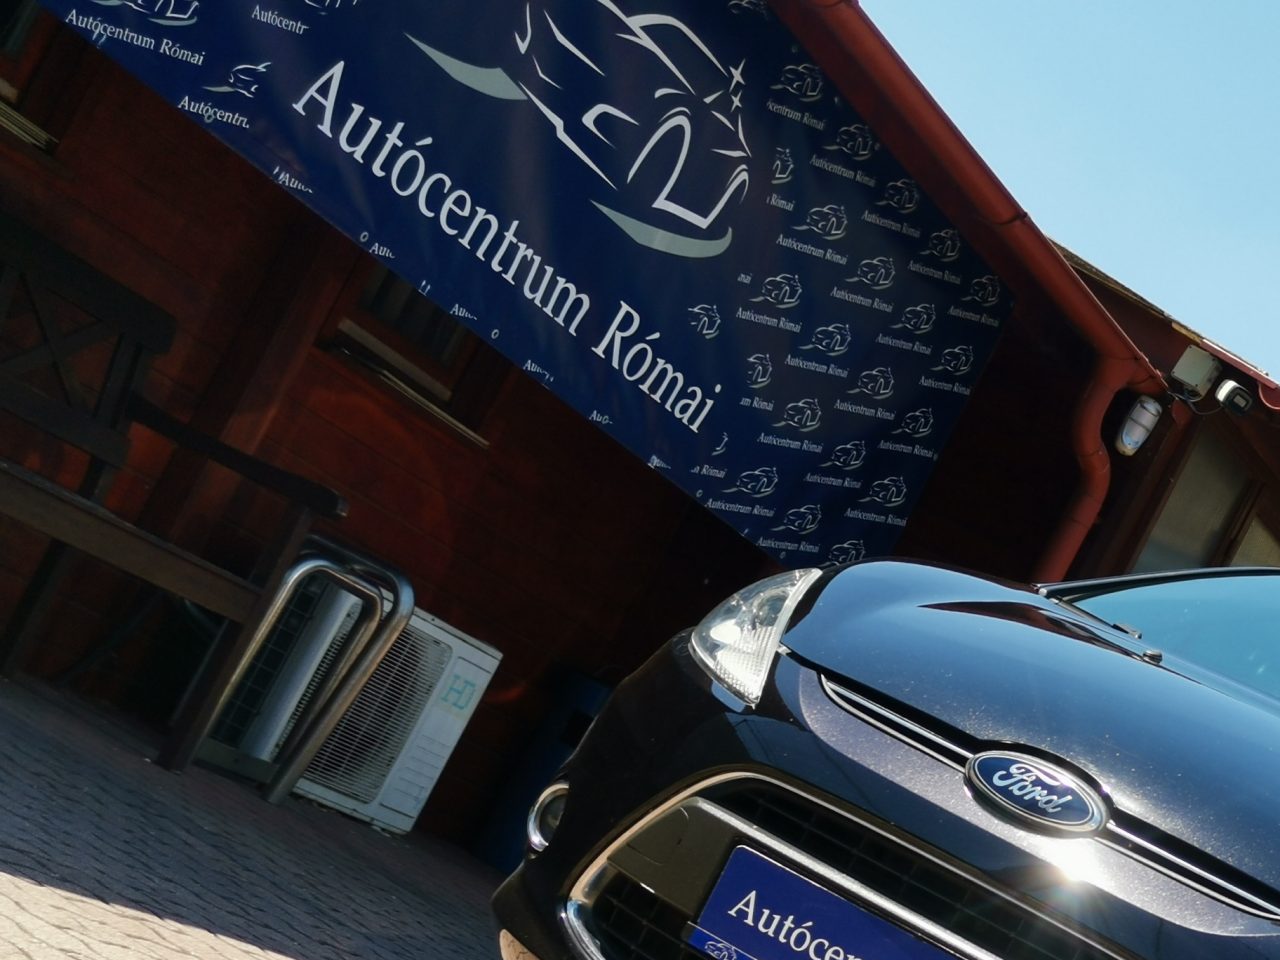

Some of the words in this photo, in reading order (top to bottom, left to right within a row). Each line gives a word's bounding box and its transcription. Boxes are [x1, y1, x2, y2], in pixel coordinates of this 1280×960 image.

[65, 8, 155, 50] Autócentrum
[160, 38, 206, 66] Római
[292, 60, 591, 337] Autócentrum
[591, 301, 722, 433] Római
[992, 763, 1072, 813] Ford
